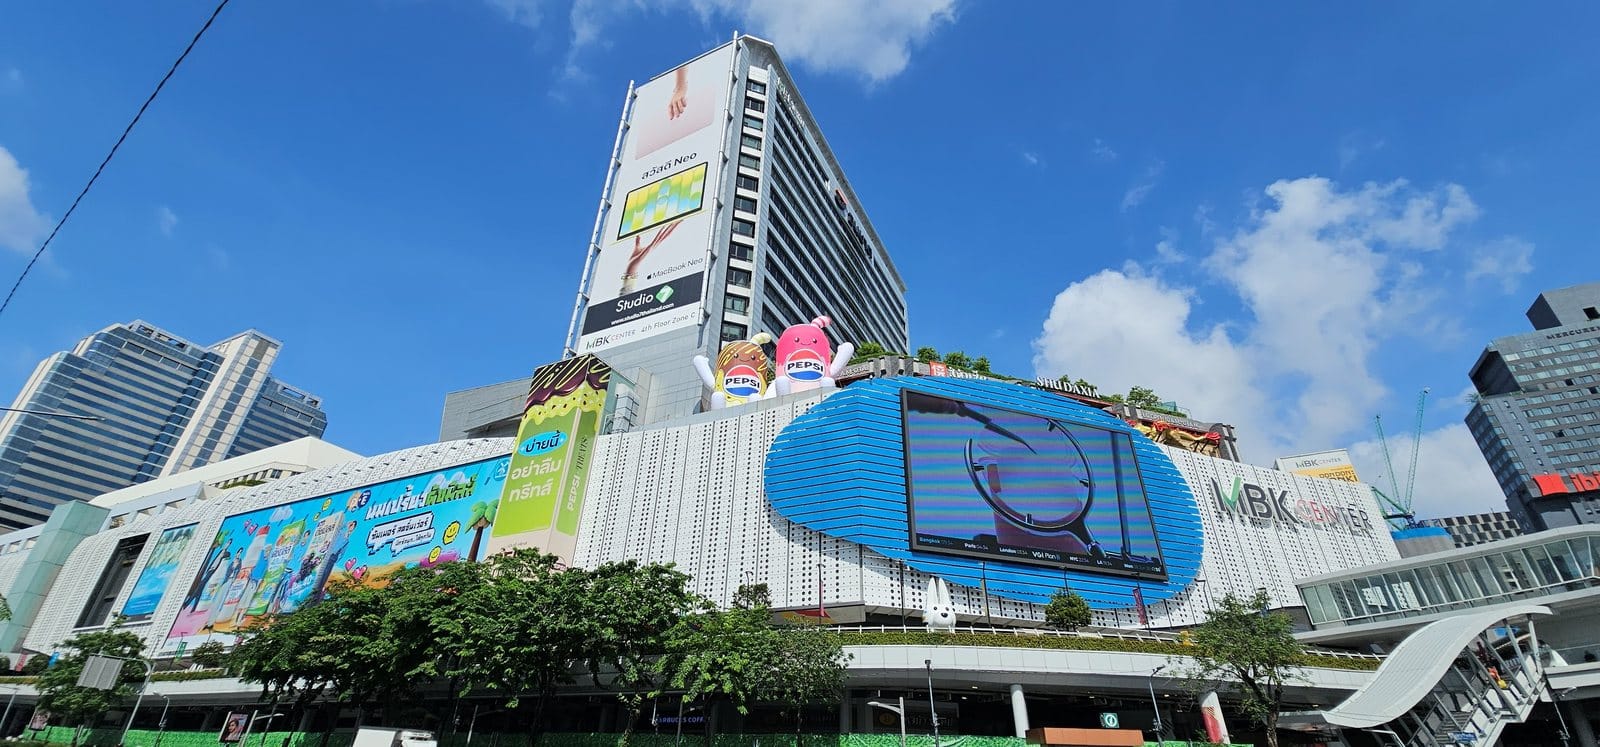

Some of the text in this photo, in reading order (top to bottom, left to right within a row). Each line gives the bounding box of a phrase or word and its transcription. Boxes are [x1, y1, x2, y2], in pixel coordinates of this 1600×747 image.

[641, 152, 697, 179] สวัสดี Neo
[652, 257, 703, 279] MacBook Neo
[615, 293, 654, 313] Studio
[586, 311, 696, 350] MBK CENTER 4th Floor Zone C
[787, 361, 824, 373] PEPSI
[725, 378, 761, 389] PEPSI
[525, 430, 561, 453] บ่ายนี้
[511, 457, 561, 480] อย่าลืม
[1295, 458, 1319, 469] MBK
[508, 478, 554, 503] ทรีทส์
[567, 475, 581, 512] PEPSI
[1211, 476, 1374, 531] MBK CENTER
